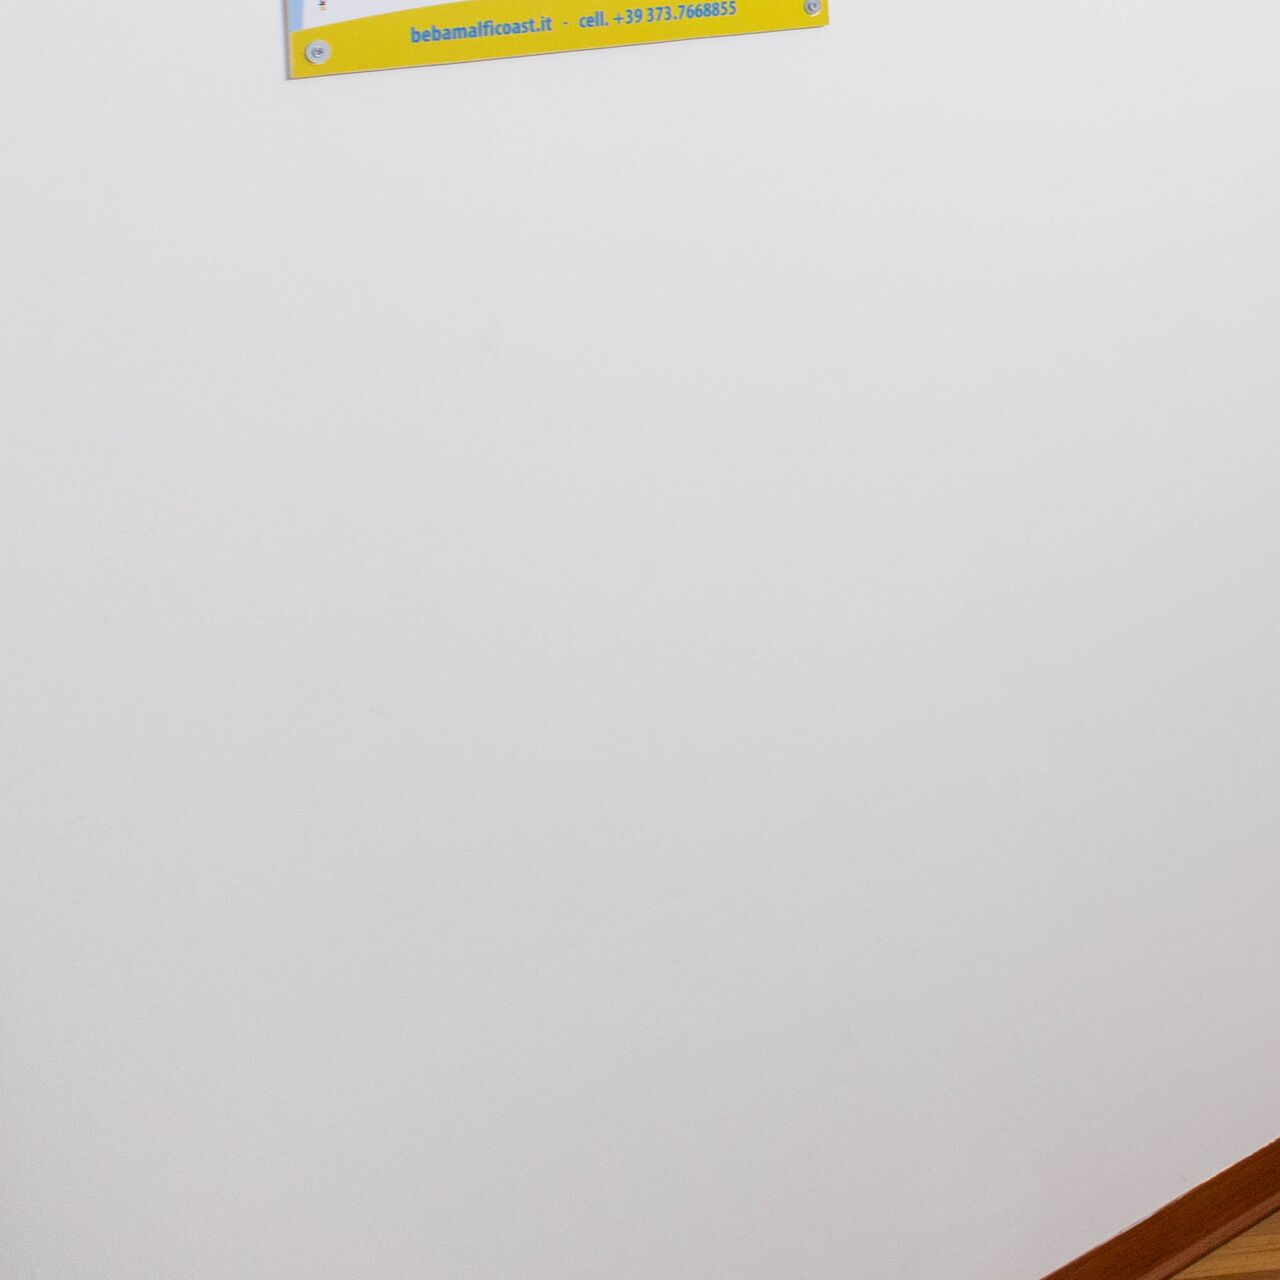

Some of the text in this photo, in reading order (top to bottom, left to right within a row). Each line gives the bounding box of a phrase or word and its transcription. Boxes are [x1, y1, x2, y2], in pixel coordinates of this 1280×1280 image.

[411, 16, 552, 43] bebamalficoast.it
[579, 11, 609, 29] cell.
[614, 9, 643, 26] +39
[647, 1, 737, 22] 373.7668855
